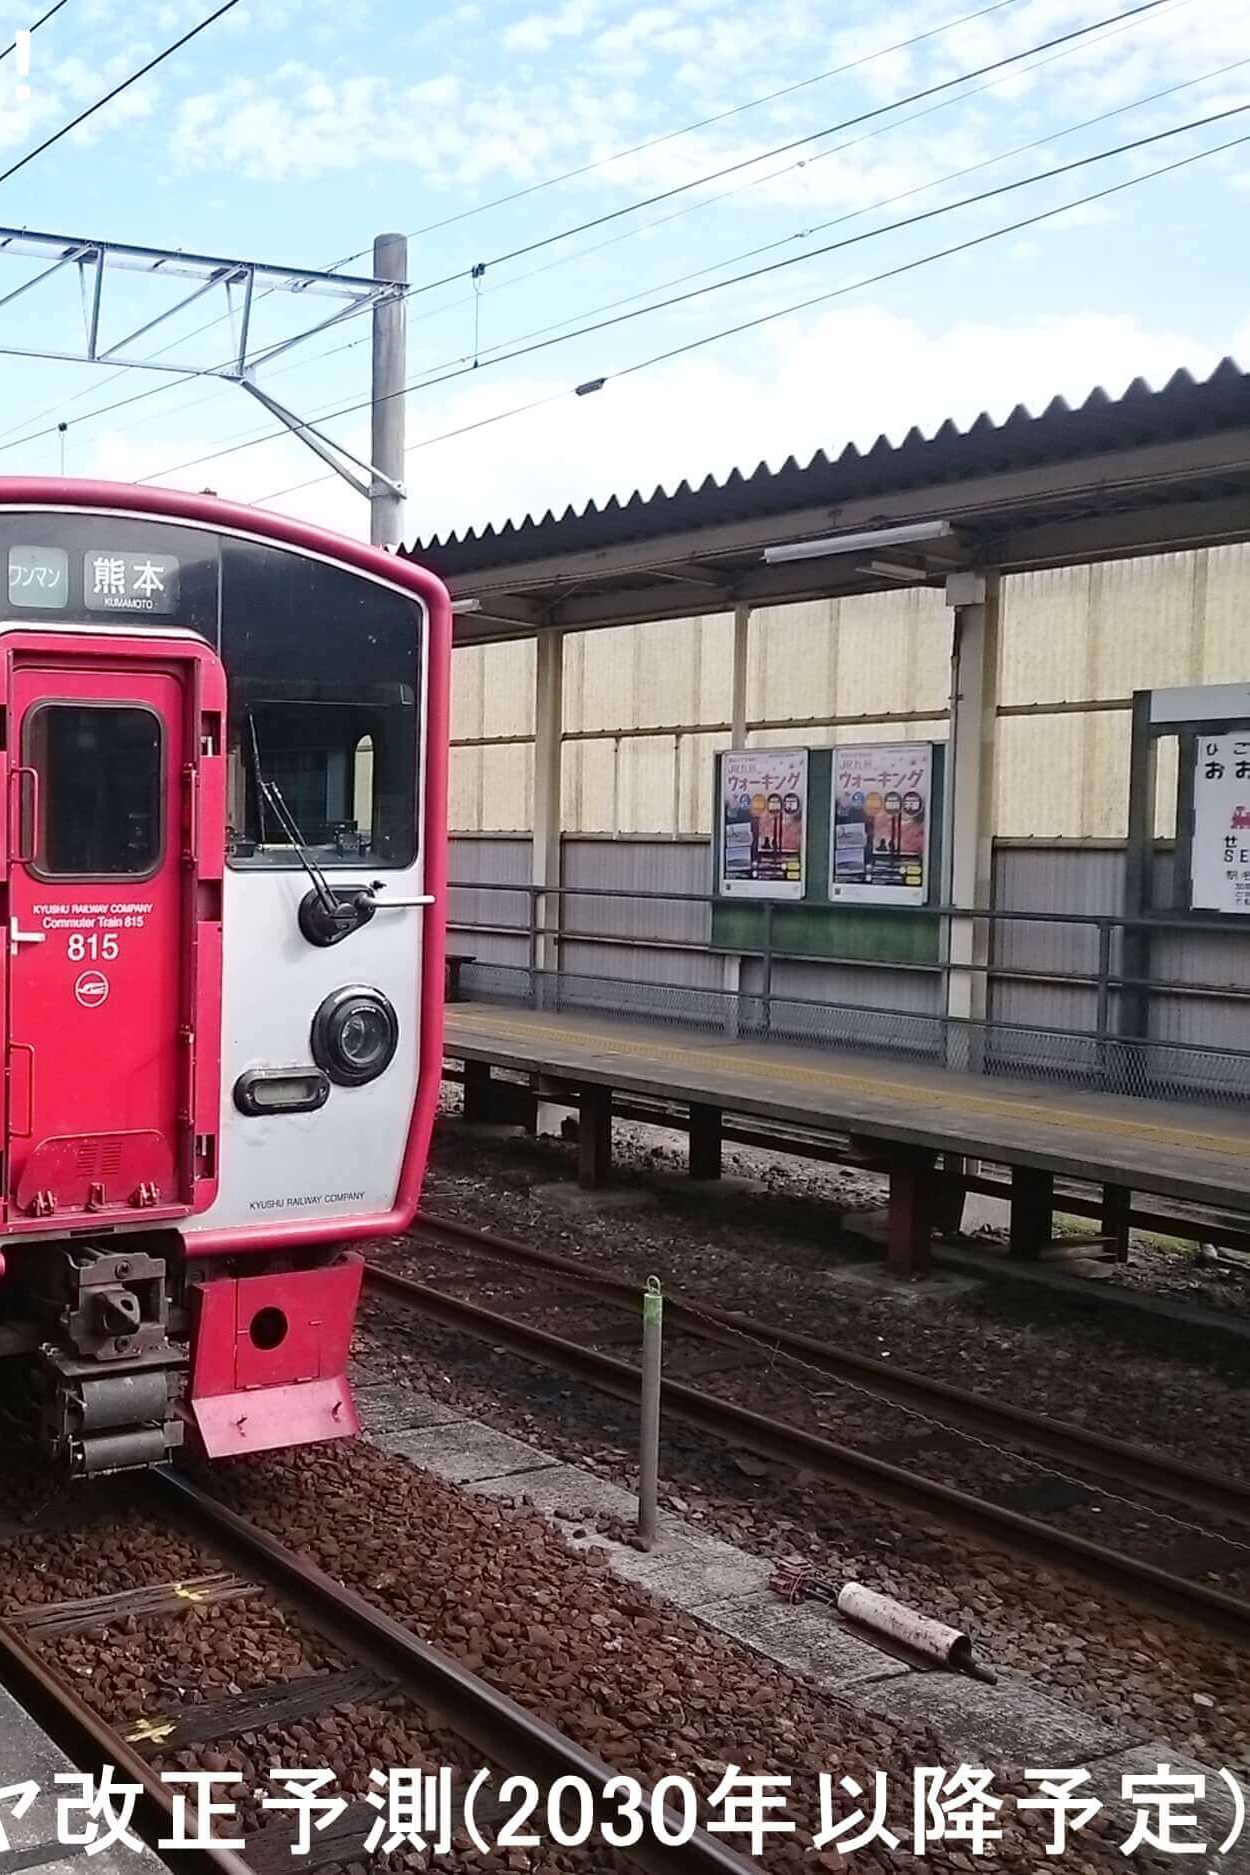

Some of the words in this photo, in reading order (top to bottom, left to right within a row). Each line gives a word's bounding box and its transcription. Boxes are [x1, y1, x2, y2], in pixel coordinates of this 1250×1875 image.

[93, 557, 165, 597] 熊本
[104, 597, 154, 610] KUMAMOTO
[728, 771, 801, 791] ウォーキング
[839, 769, 925, 788] ウォーキング
[33, 904, 70, 914] KYUSHU
[72, 904, 108, 914] RAILWAY
[109, 903, 153, 913] COMPANY
[43, 916, 96, 929] Commuter
[98, 916, 123, 928] Train
[123, 916, 144, 927] 815
[67, 933, 119, 961] 815
[250, 1199, 285, 1210] KYUSHU
[286, 1196, 323, 1207] RAILWAY
[324, 1191, 366, 1203] COMPANY
